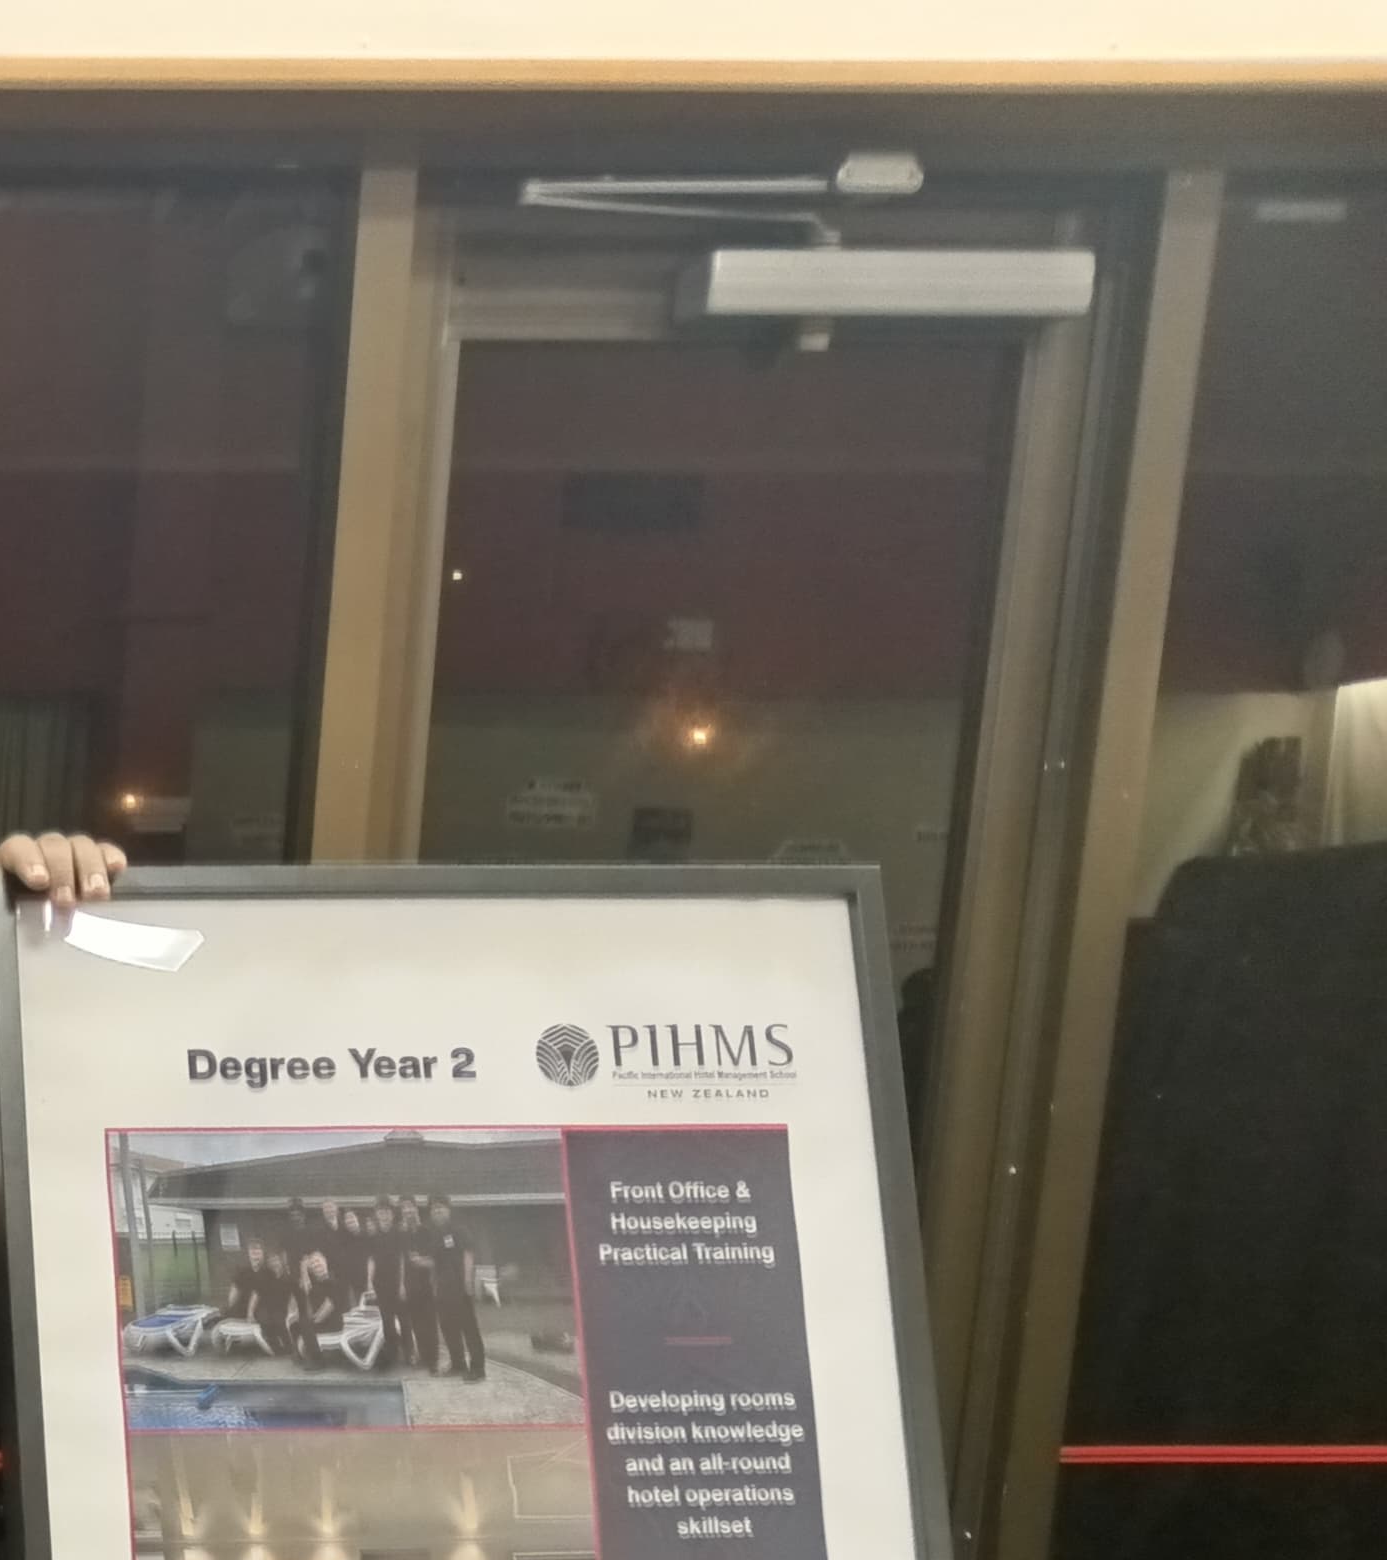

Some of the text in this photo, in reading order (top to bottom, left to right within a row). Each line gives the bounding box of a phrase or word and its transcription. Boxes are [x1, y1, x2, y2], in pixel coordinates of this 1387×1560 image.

[605, 1023, 794, 1068] PIHMS
[187, 1047, 477, 1089] Degree Year 2
[612, 1070, 797, 1082] Pacific International Hotel Management School
[647, 1088, 770, 1099] NEW ZEALAND
[610, 1180, 751, 1202] Front Office &
[610, 1212, 758, 1236] Housekeeping
[599, 1241, 776, 1266] Practical Training
[609, 1391, 796, 1416] Developing rooms
[606, 1420, 805, 1446] division knowledge
[625, 1452, 791, 1474] and an all-round
[627, 1484, 795, 1510] hotel operations
[677, 1516, 754, 1538] skillset
